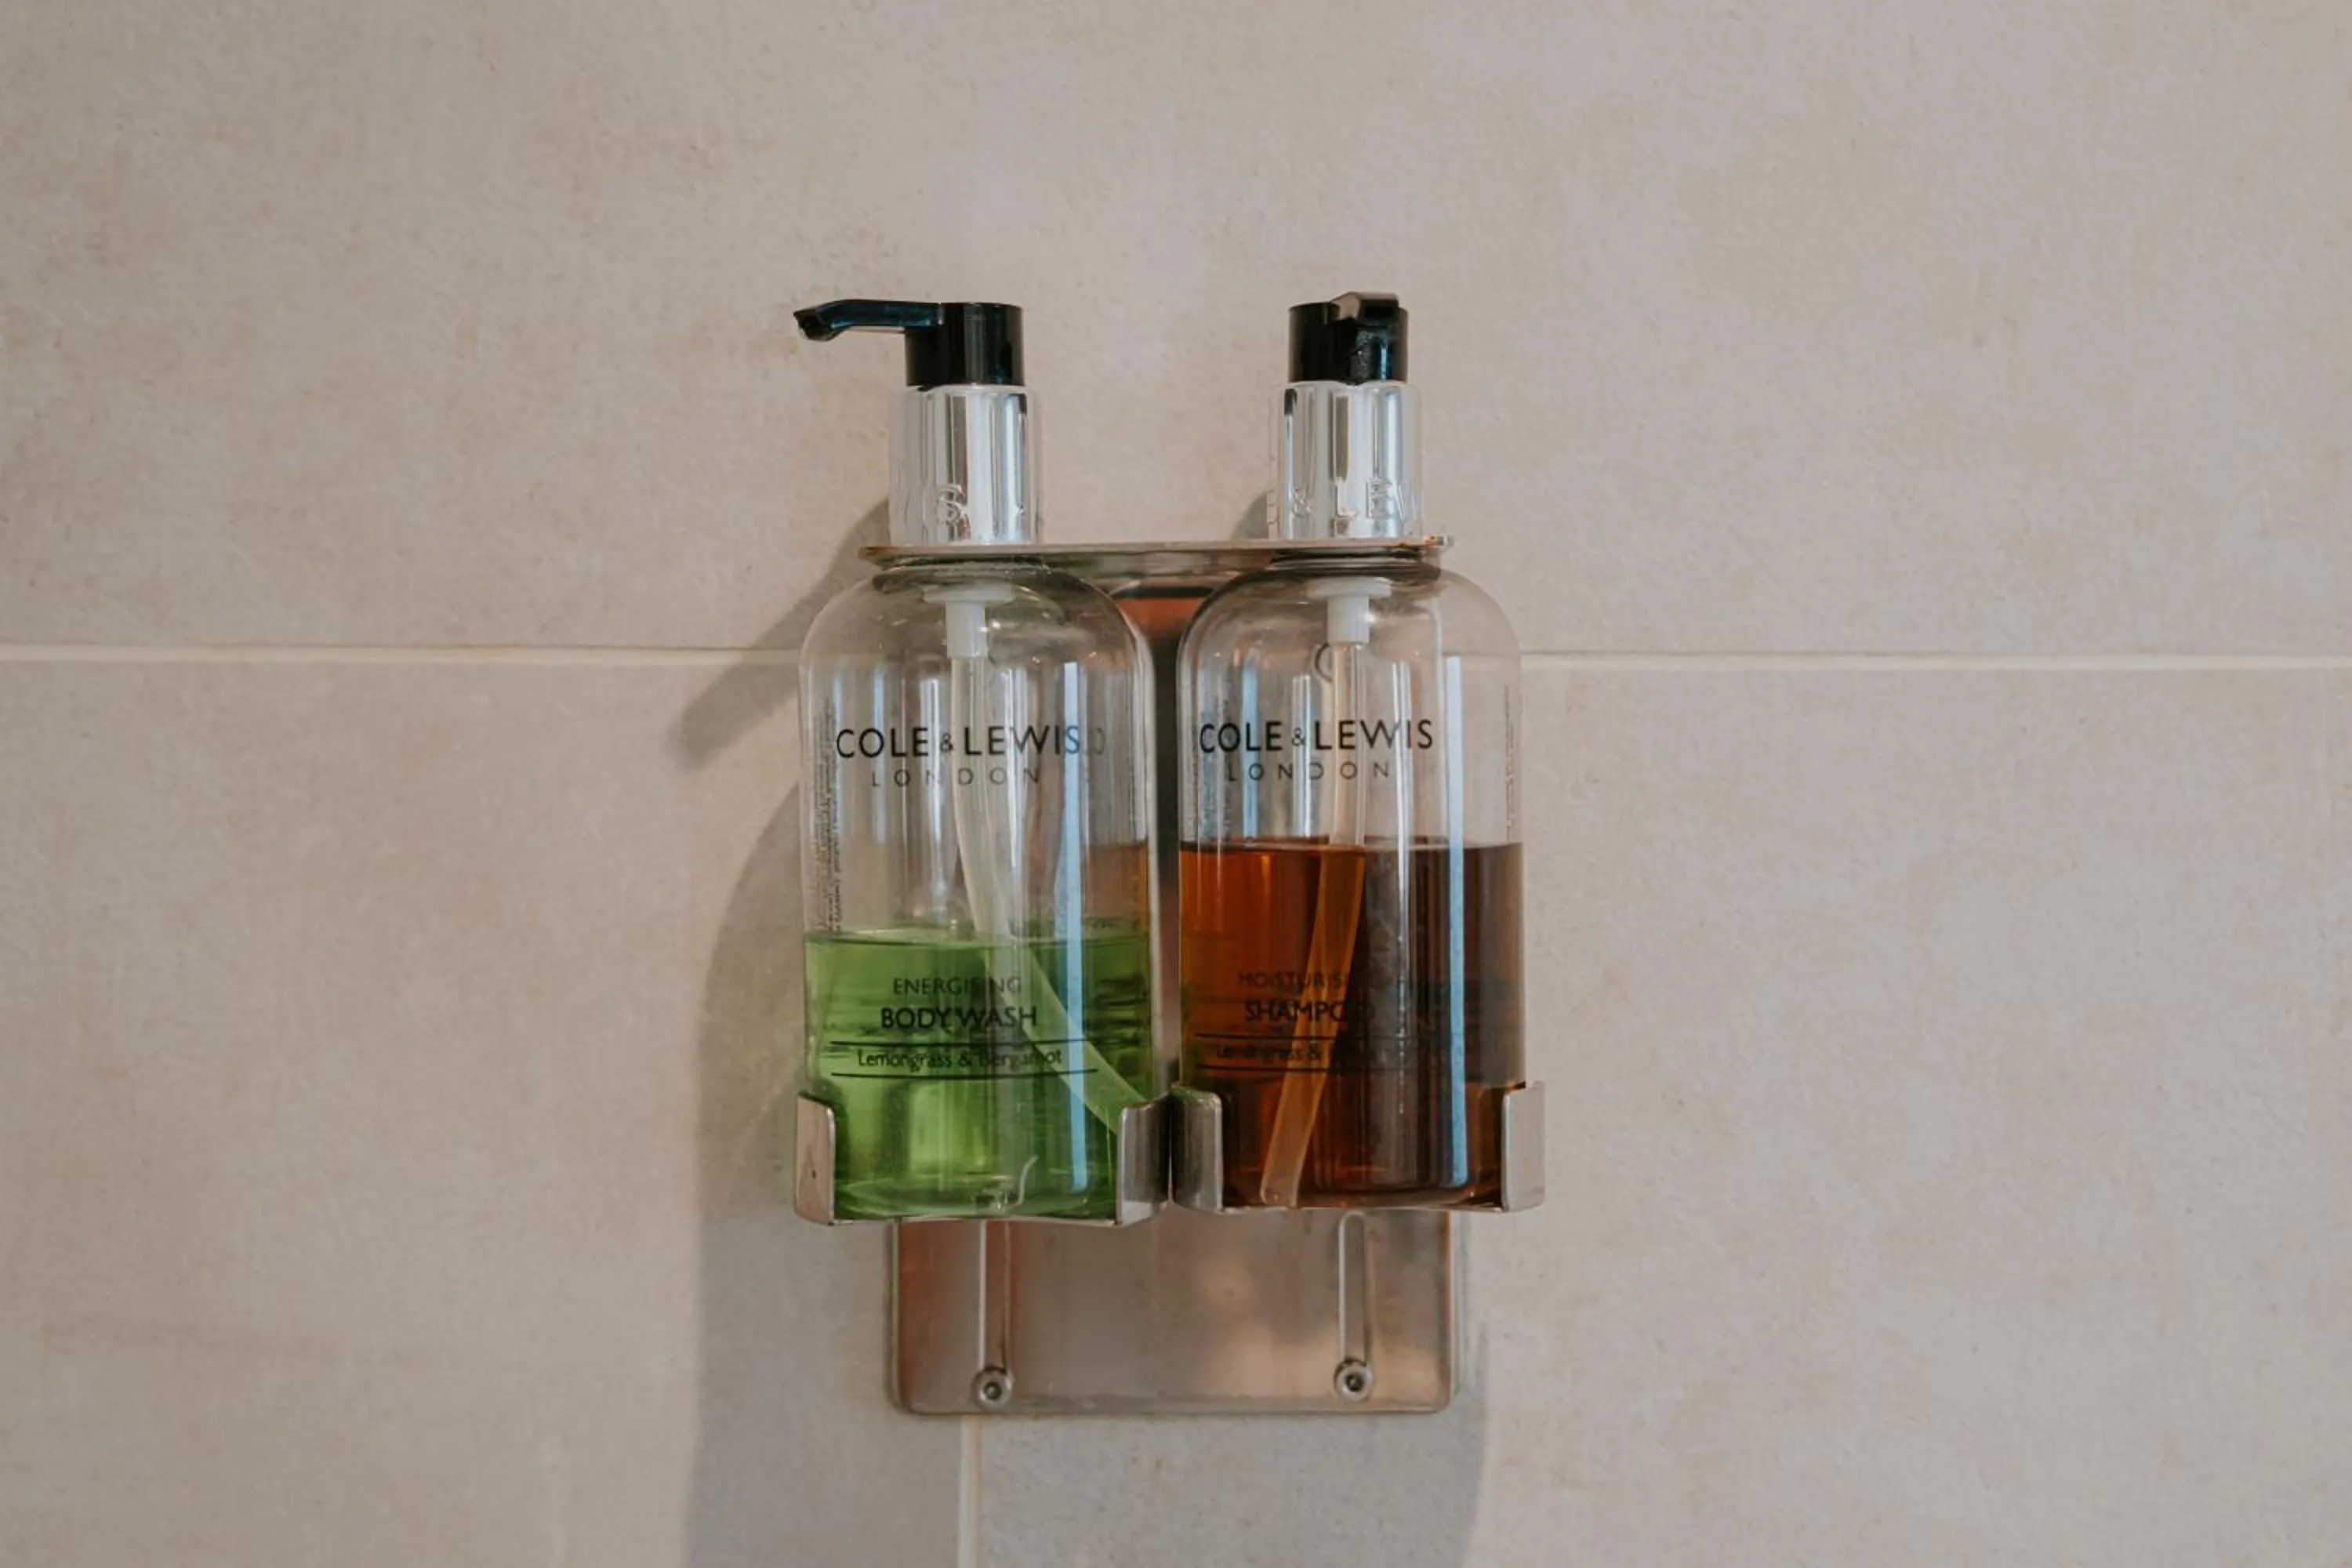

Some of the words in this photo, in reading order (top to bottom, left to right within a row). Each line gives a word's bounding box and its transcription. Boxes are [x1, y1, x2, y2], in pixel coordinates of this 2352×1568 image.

[836, 727, 930, 758] COLE
[939, 731, 954, 753] &
[964, 724, 1081, 757] LEWIS
[1200, 720, 1283, 753] COLE
[1290, 727, 1306, 747] &
[1314, 719, 1434, 750] LEWIS
[871, 765, 1040, 788] LONDON
[1227, 760, 1390, 782] LONDON
[1243, 1000, 1369, 1023] SHAMPO
[857, 1049, 953, 1072] Lemongrass
[958, 1051, 975, 1069] &
